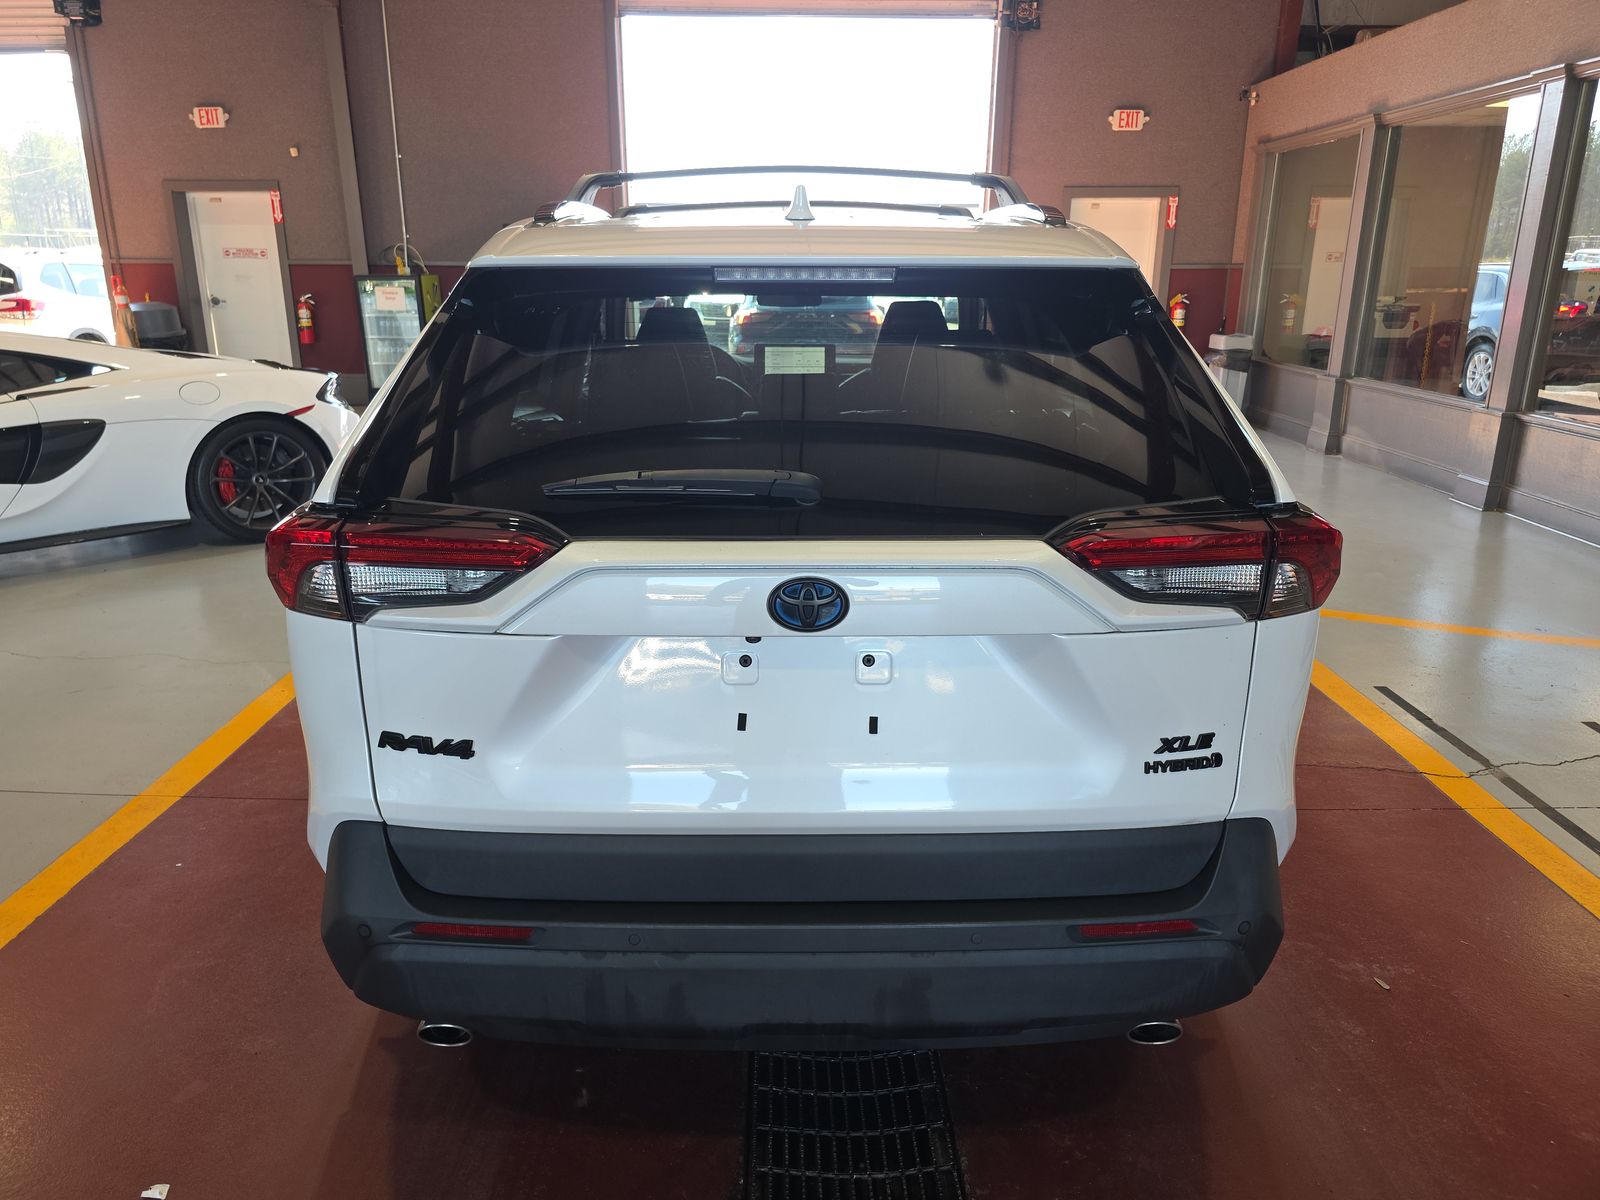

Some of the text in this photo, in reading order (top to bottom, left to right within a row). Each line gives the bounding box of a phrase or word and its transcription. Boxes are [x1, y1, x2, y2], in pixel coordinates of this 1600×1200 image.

[198, 108, 220, 126] EXIT
[1118, 110, 1141, 129] EXIT
[378, 730, 476, 760] RAV4
[1153, 732, 1216, 754] XLE
[1144, 755, 1211, 775] HYBRID
